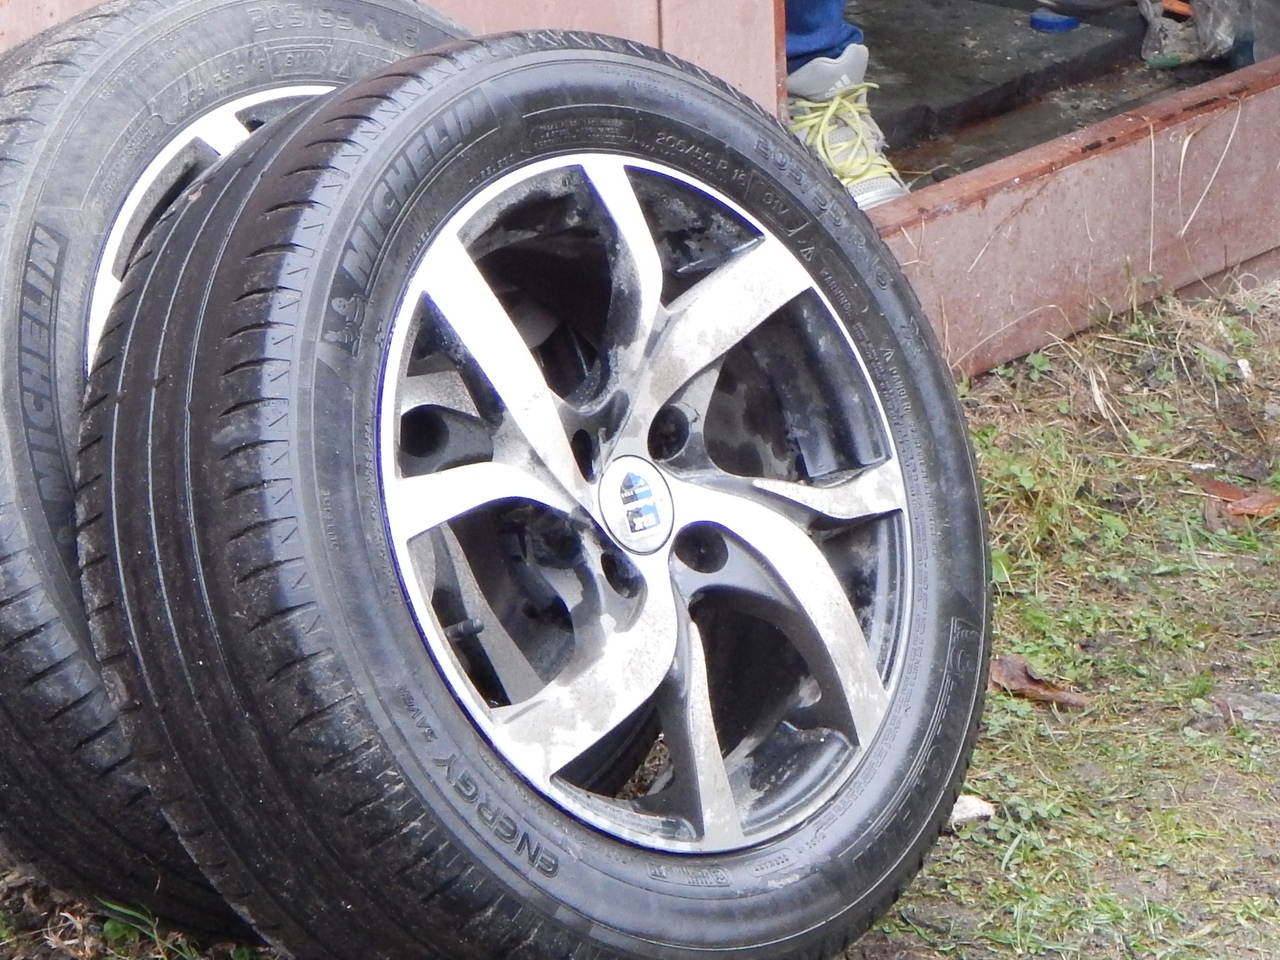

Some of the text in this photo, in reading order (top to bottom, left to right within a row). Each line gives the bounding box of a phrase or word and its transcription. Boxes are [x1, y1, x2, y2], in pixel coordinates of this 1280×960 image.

[247, 3, 354, 33] 205/55
[341, 88, 495, 289] MICHELIN
[655, 131, 715, 167] 205/55
[732, 168, 749, 188] 16
[753, 134, 847, 227] 205/55
[21, 225, 61, 501] MICHELIN
[400, 683, 560, 879] ENERGY SAVER
